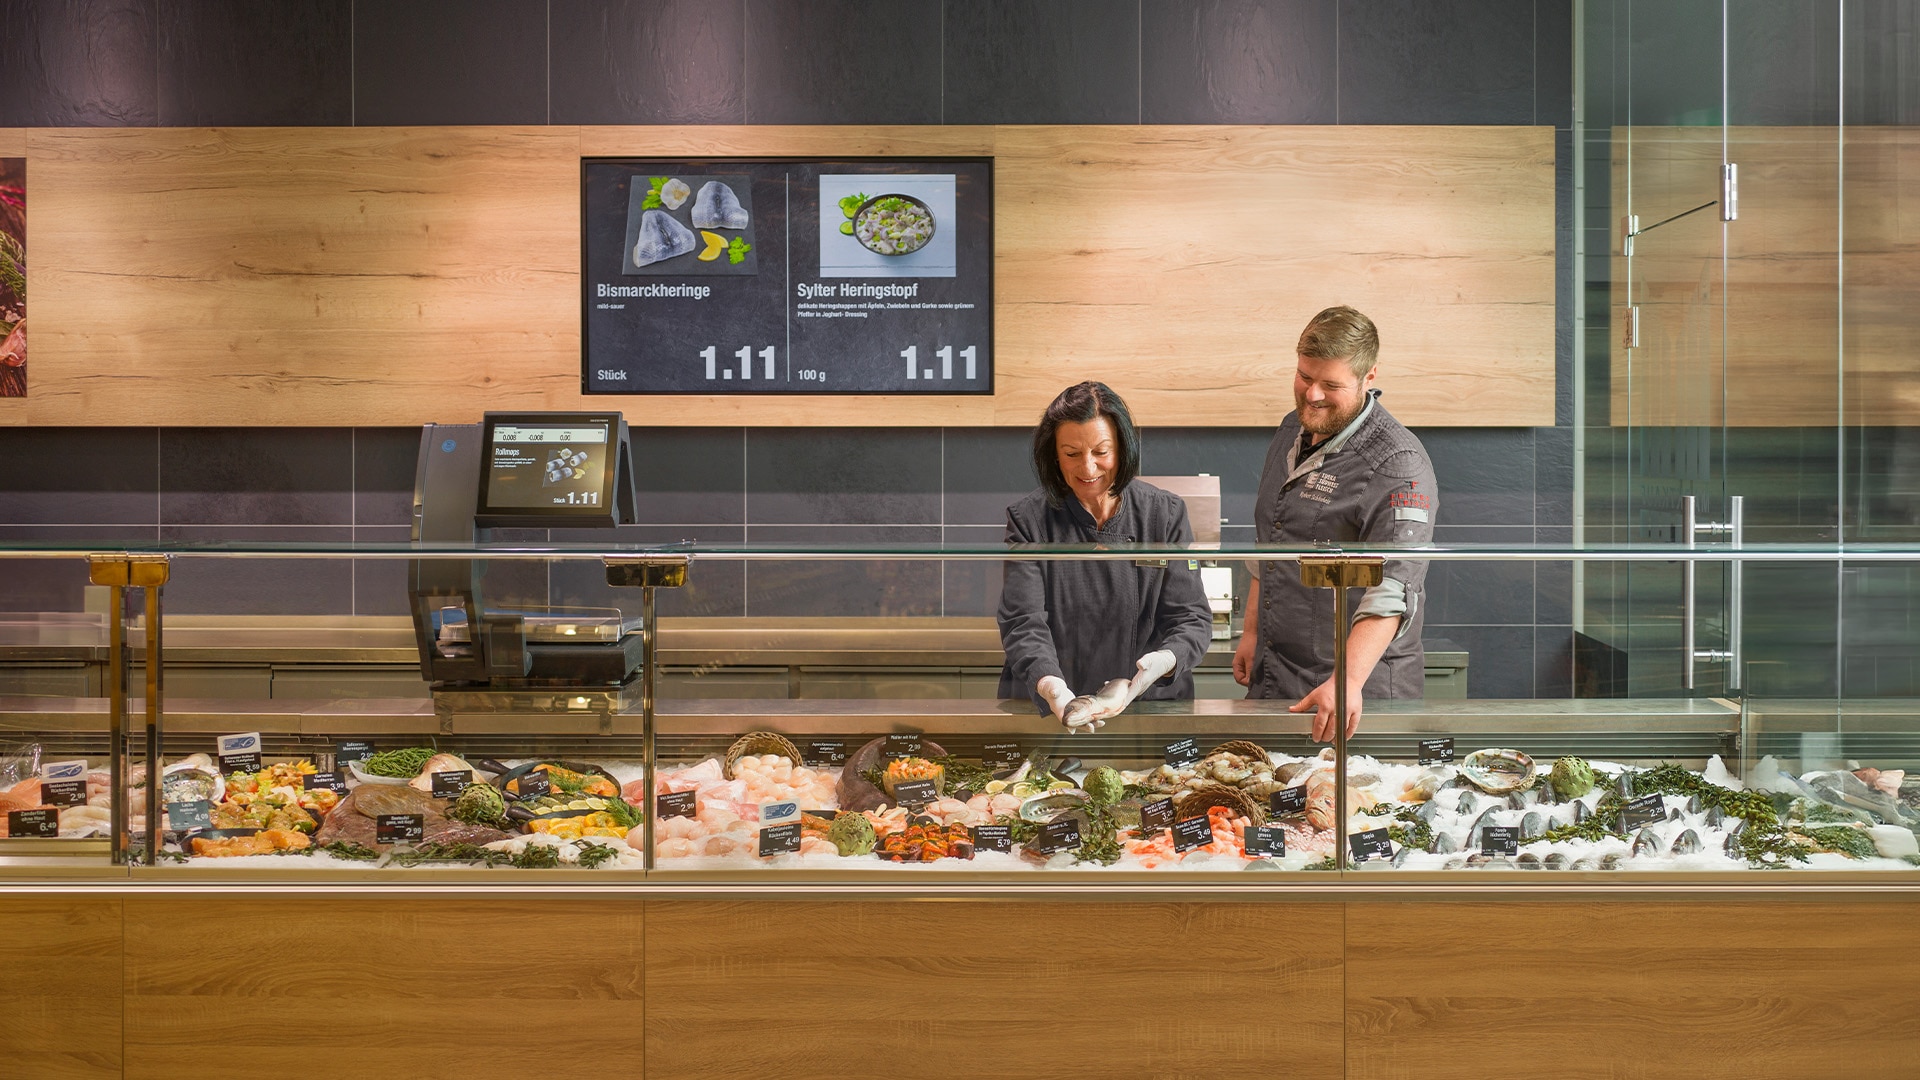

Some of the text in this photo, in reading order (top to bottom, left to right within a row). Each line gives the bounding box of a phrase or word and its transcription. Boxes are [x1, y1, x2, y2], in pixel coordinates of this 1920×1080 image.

[598, 283, 710, 299] Bismarckheringe
[798, 283, 918, 299] Sylter Heringstopf
[700, 345, 775, 380] 1.11
[901, 345, 976, 380] 1.11
[598, 369, 627, 380] Stück
[798, 370, 826, 382] 100 g
[568, 492, 598, 504] 1.11
[70, 793, 85, 801] 2.99
[1650, 807, 1663, 817] 2.29
[40, 822, 56, 831] 6.49
[406, 828, 422, 836] 2.99
[1197, 828, 1210, 839] 3.49
[785, 837, 800, 846] 4.49
[998, 839, 1010, 847] 5.79
[1270, 841, 1284, 850] 4.49
[1376, 841, 1389, 851] 3.29
